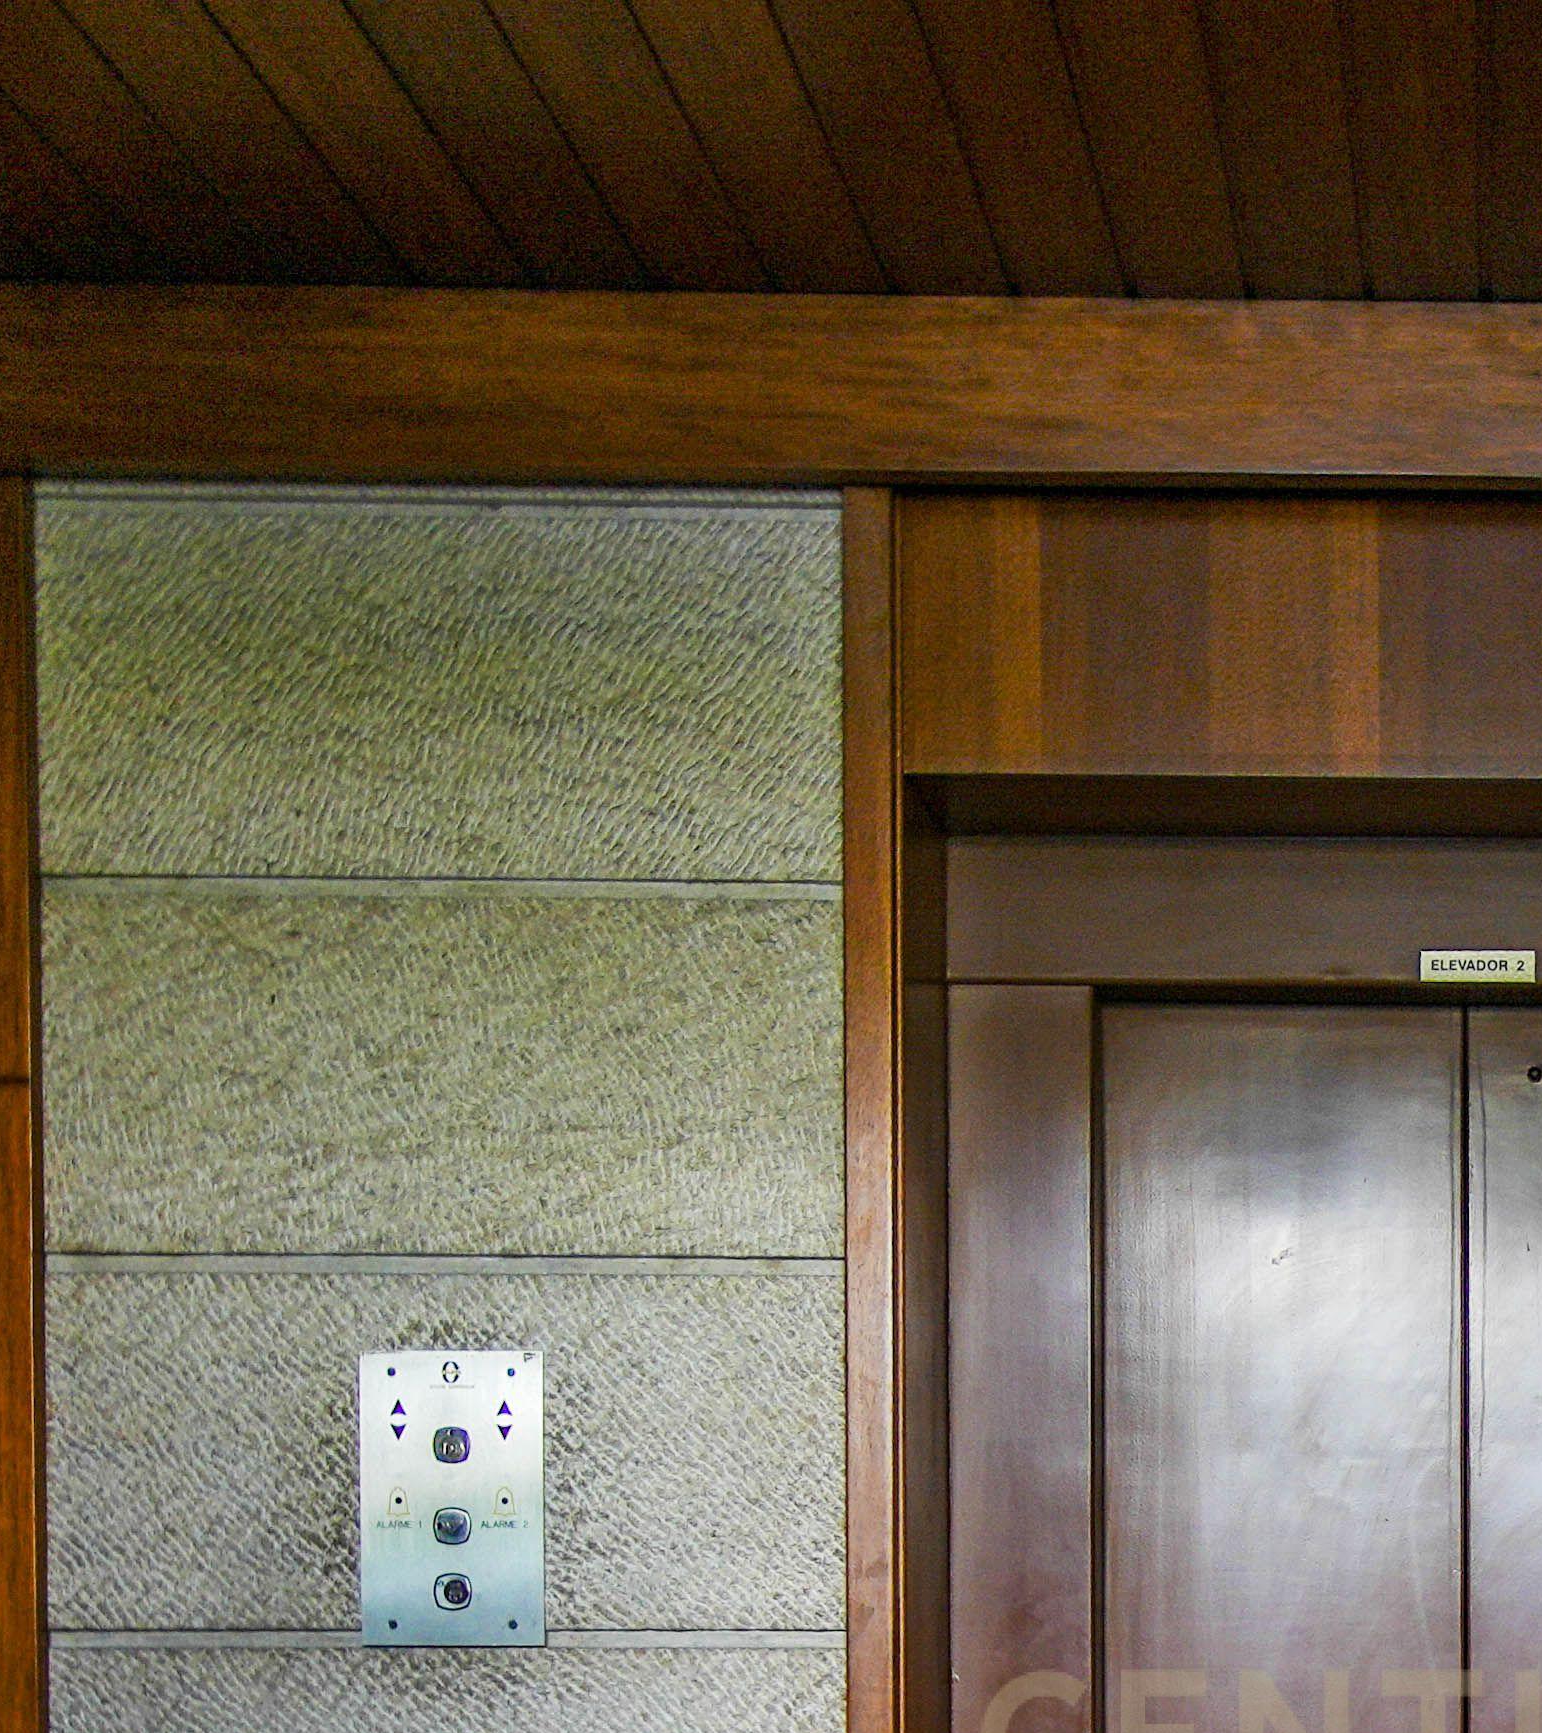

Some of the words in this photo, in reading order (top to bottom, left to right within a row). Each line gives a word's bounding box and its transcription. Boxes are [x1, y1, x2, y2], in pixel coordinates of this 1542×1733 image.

[1430, 959, 1508, 971] ELEVADOR
[1516, 960, 1525, 971] 2
[376, 1520, 412, 1529] ALARME
[480, 1520, 518, 1529] ALARME
[523, 1520, 529, 1529] 2
